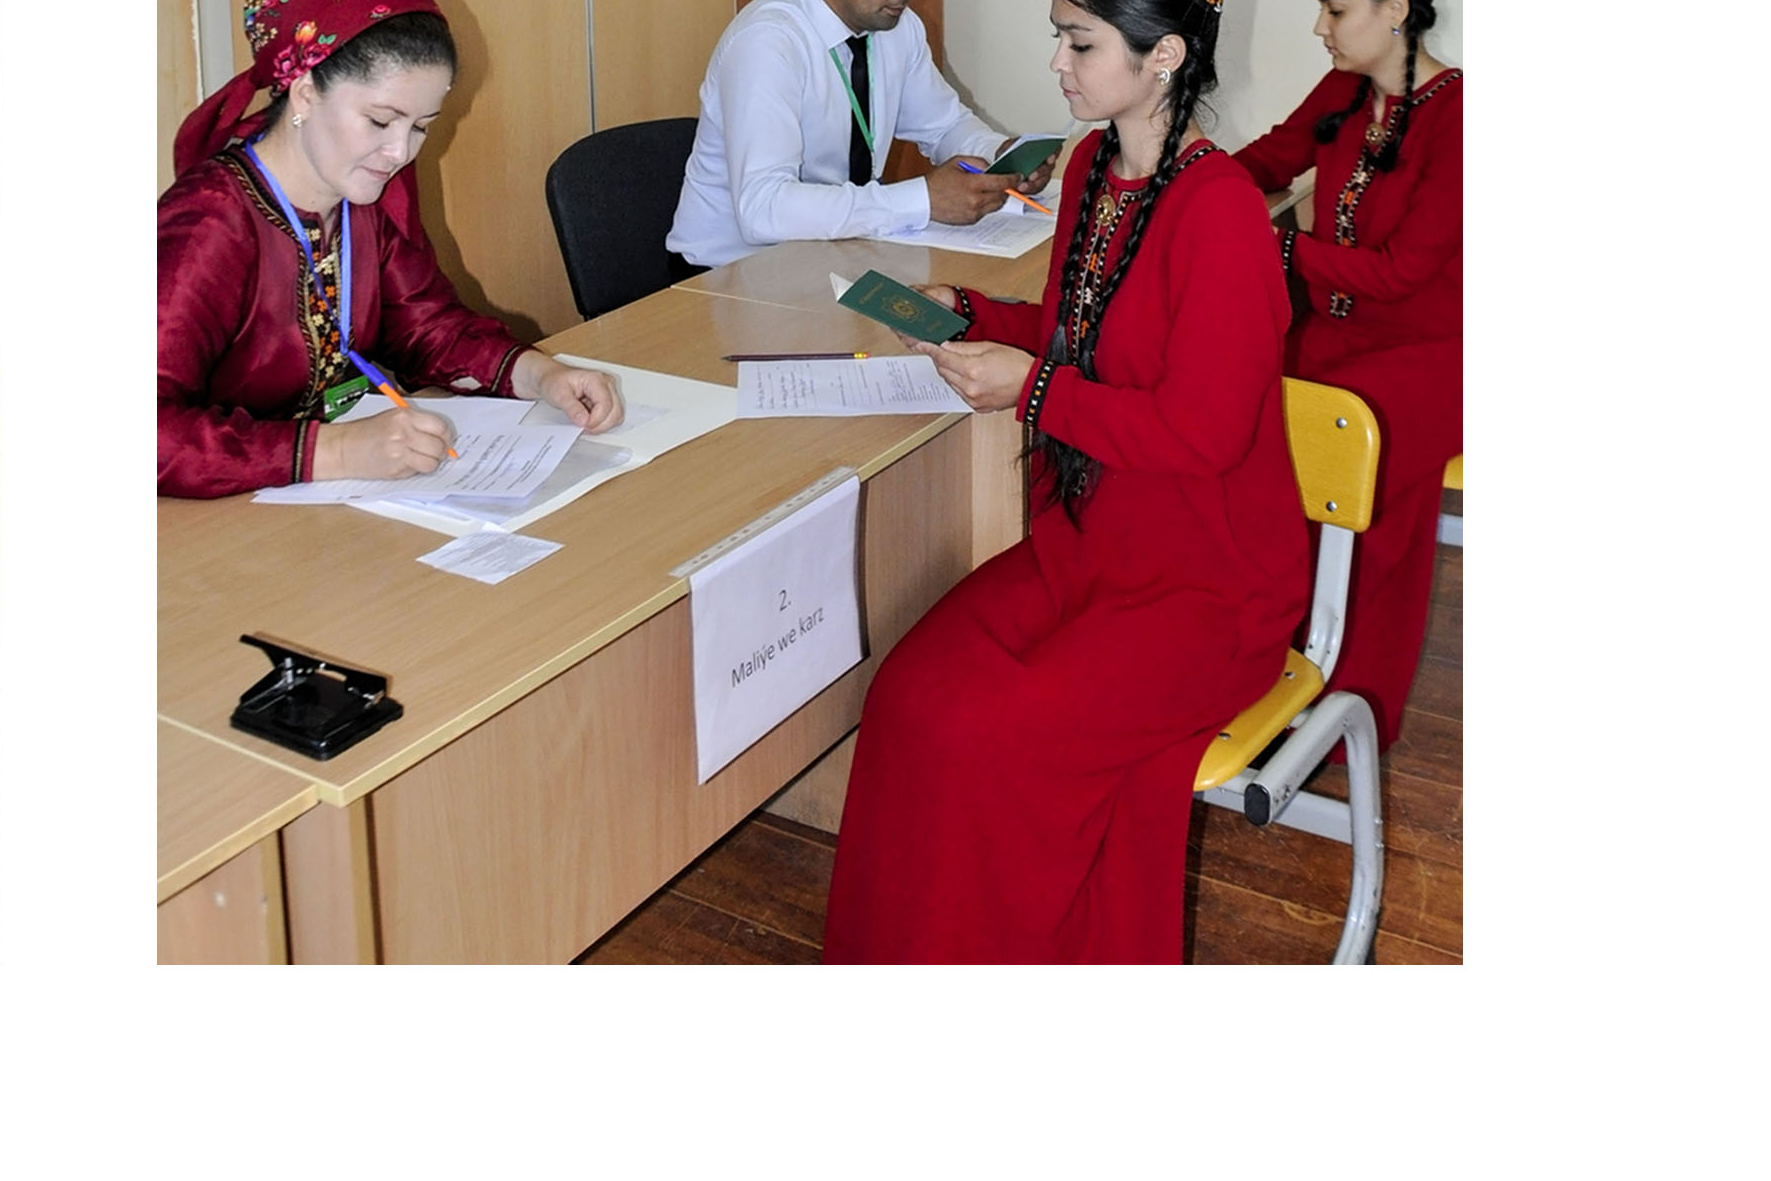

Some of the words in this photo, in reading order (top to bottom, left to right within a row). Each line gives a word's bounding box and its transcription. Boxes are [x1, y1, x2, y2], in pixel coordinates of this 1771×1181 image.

[778, 589, 792, 612] 2.
[731, 644, 776, 688] Maliýe
[777, 628, 797, 651] we
[798, 607, 825, 636] karz
